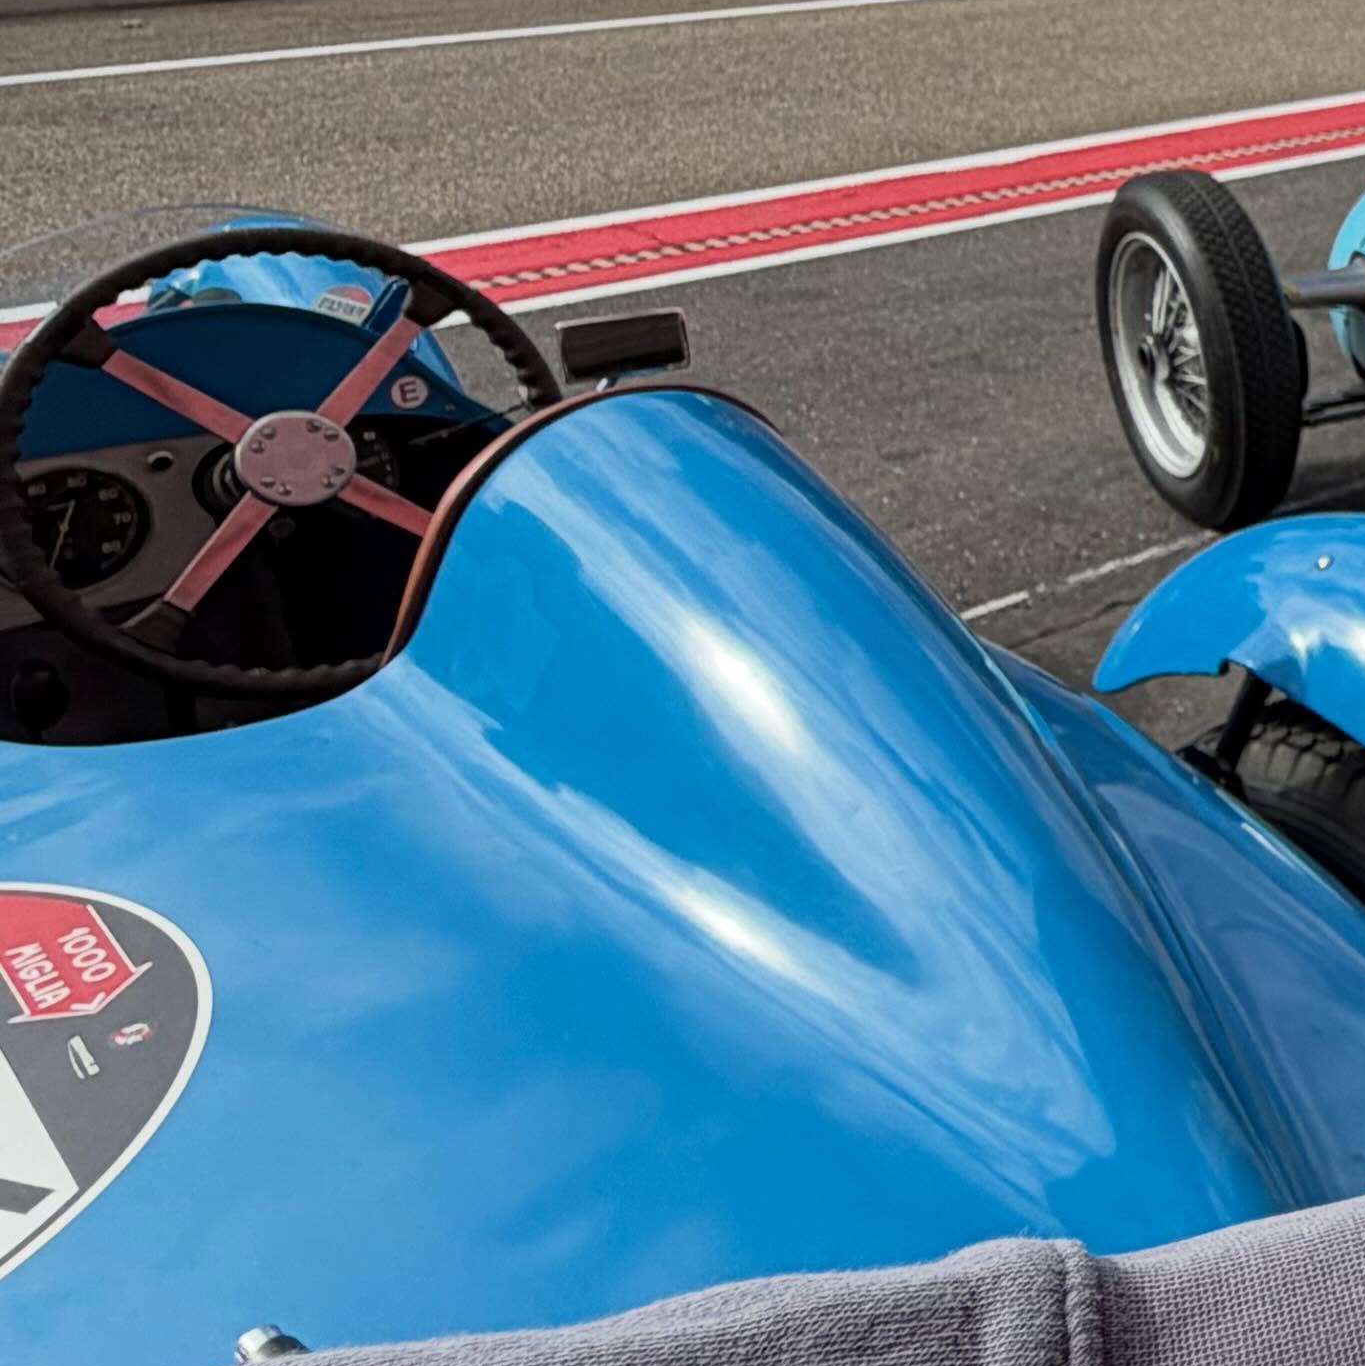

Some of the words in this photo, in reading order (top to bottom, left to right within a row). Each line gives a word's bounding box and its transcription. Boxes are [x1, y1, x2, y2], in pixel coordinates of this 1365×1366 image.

[398, 379, 420, 404] E
[5, 942, 71, 1010] MIGLIA
[58, 926, 117, 984] 1000
